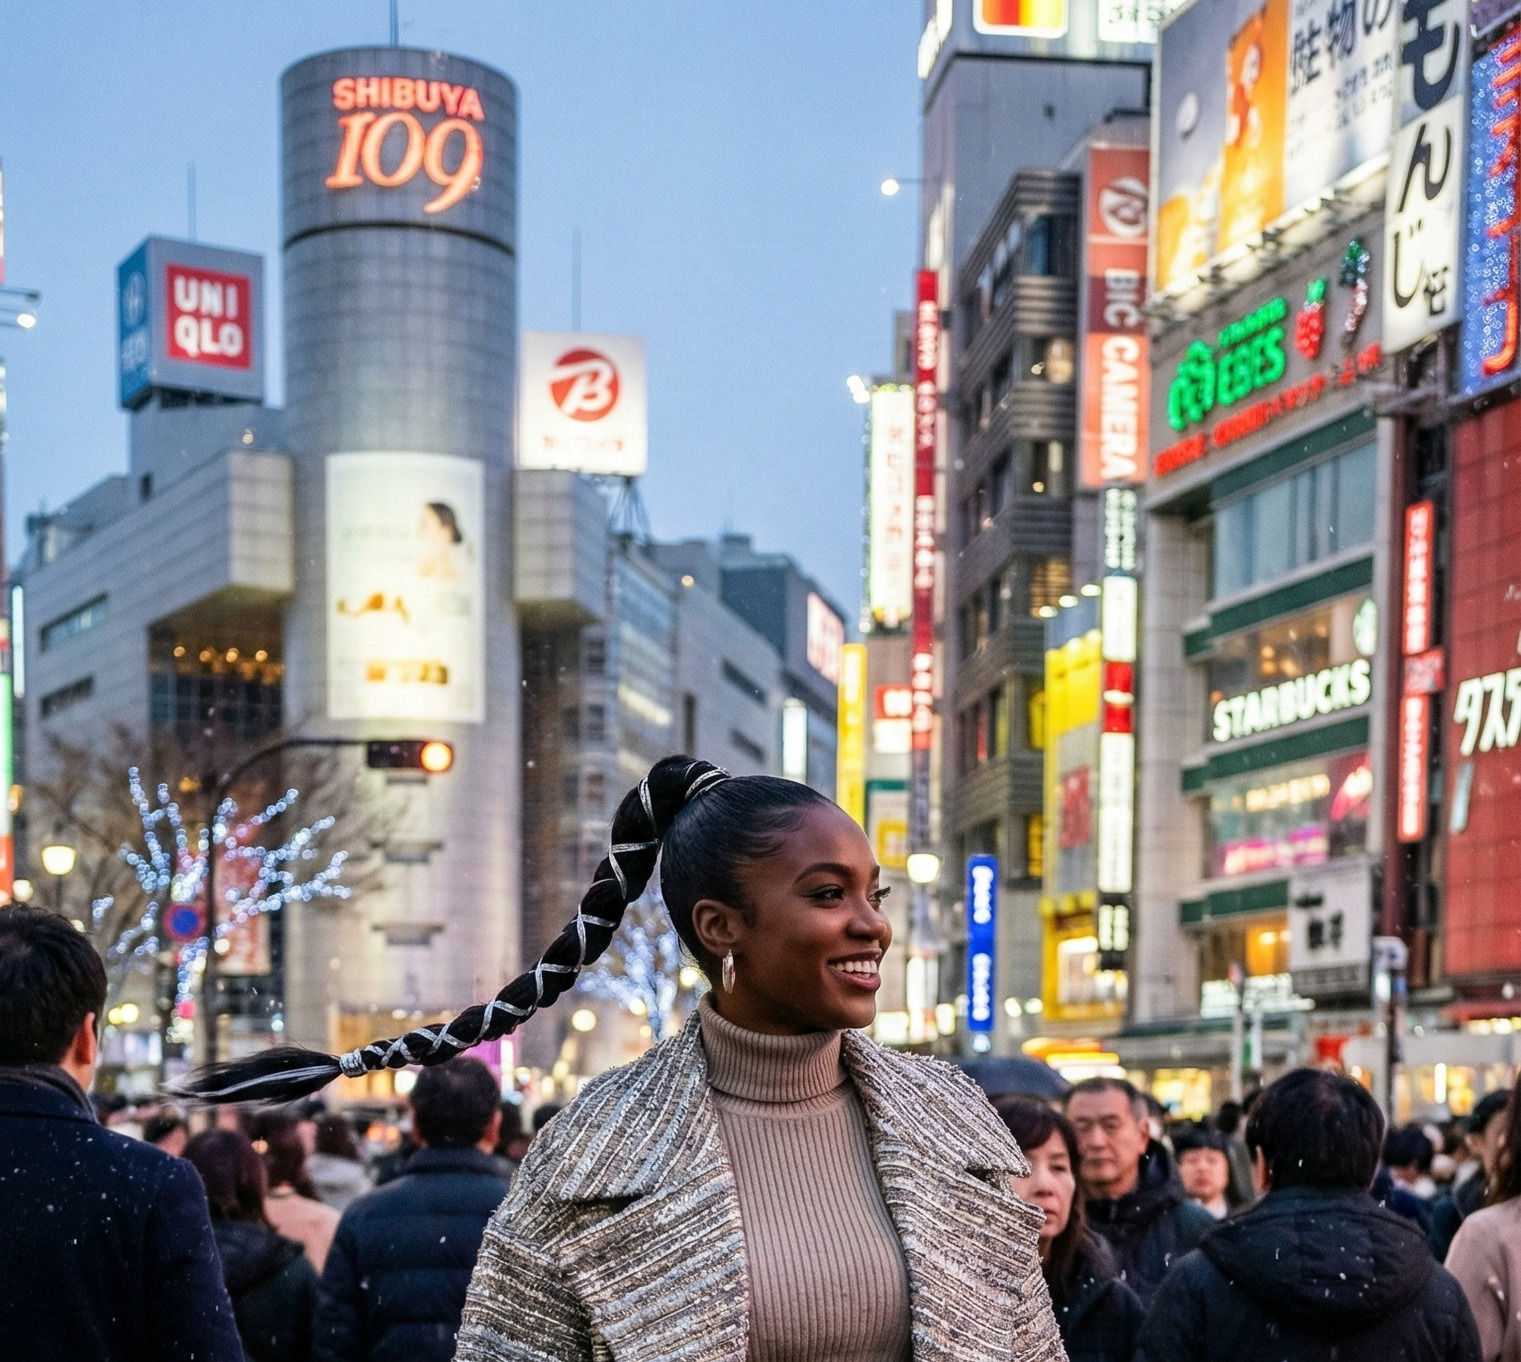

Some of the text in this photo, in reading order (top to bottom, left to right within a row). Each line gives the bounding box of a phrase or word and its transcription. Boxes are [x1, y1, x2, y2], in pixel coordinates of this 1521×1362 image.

[332, 75, 485, 122] SHIBUYA
[325, 111, 484, 214] 109
[174, 274, 239, 321] UNI
[1104, 268, 1140, 328] BIC
[174, 314, 244, 358] QLO
[1101, 335, 1139, 480] CAMERA
[1213, 659, 1371, 742] STARBUCKS
